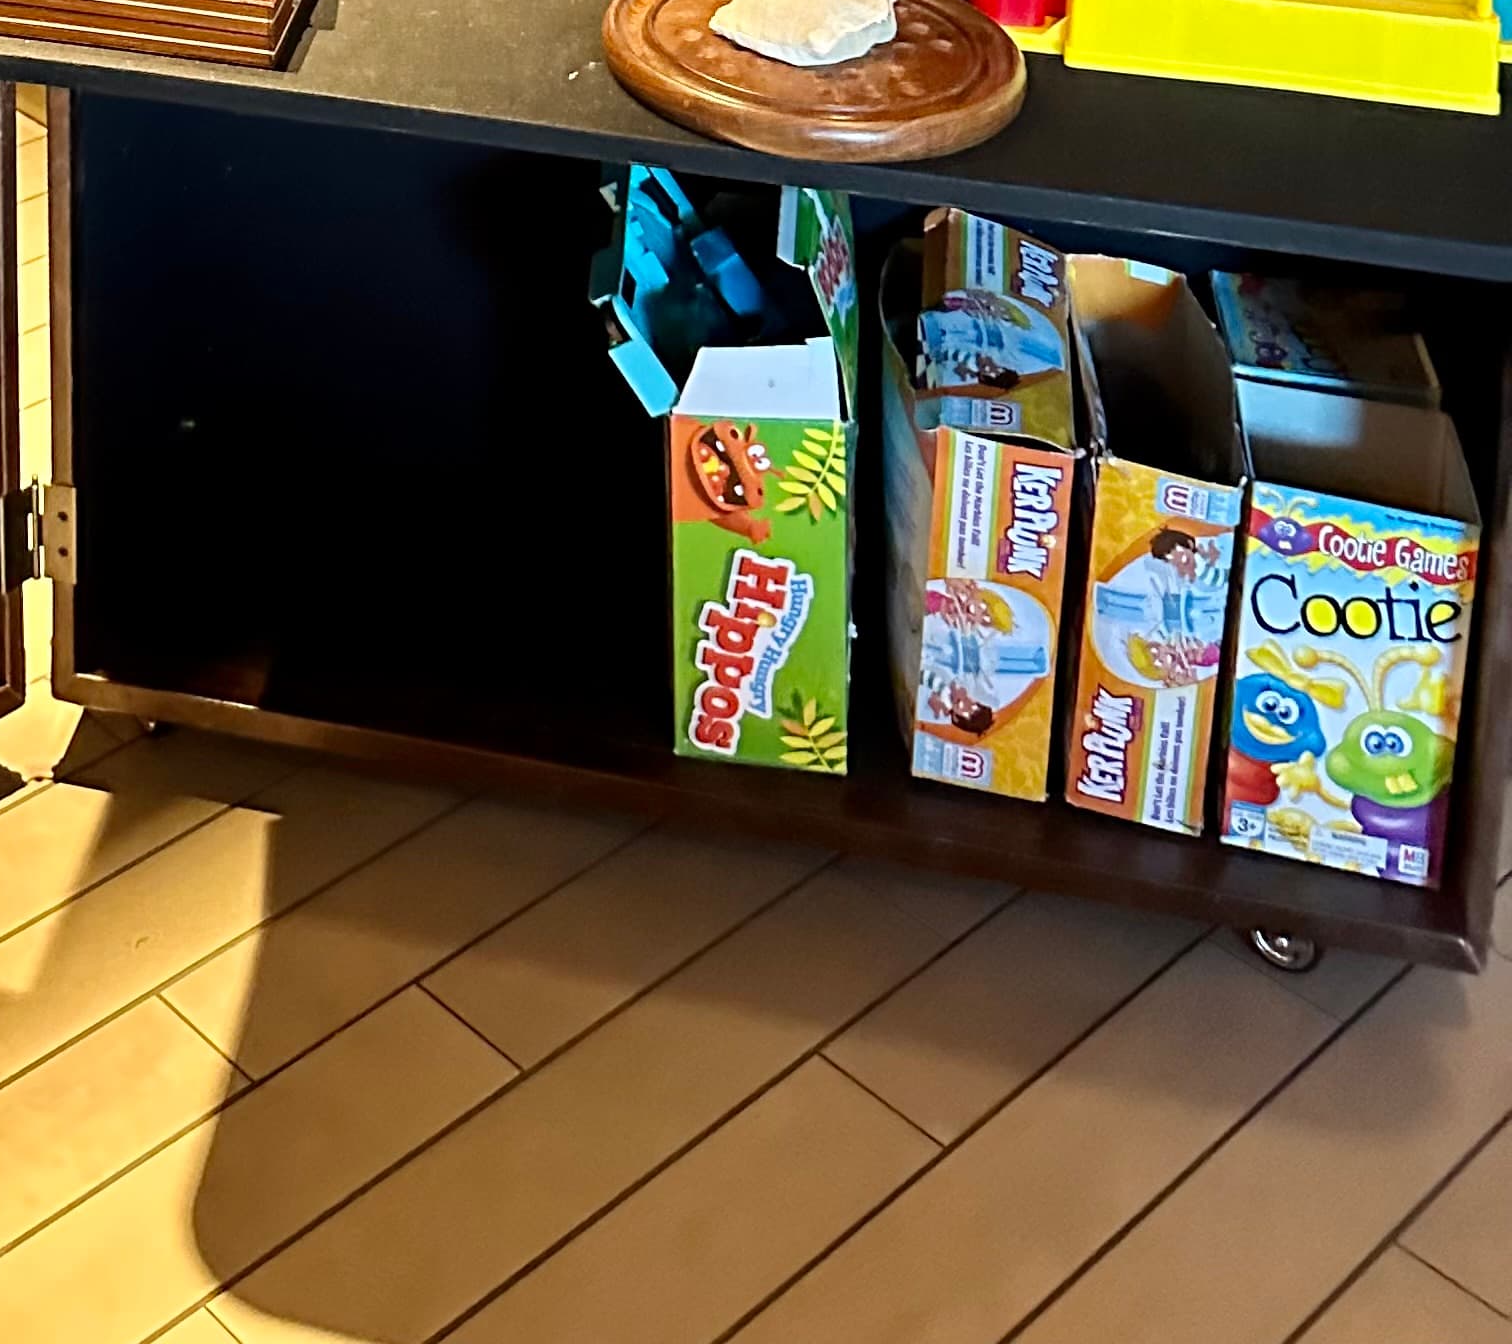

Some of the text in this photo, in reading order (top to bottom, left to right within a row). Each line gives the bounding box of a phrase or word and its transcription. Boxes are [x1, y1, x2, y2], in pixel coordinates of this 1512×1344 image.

[1317, 526, 1470, 582] Cootie Games
[749, 576, 809, 715] Hungry Hungry
[1249, 573, 1464, 646] Cootie
[694, 554, 791, 753] Hippos
[1237, 817, 1258, 834] 3+
